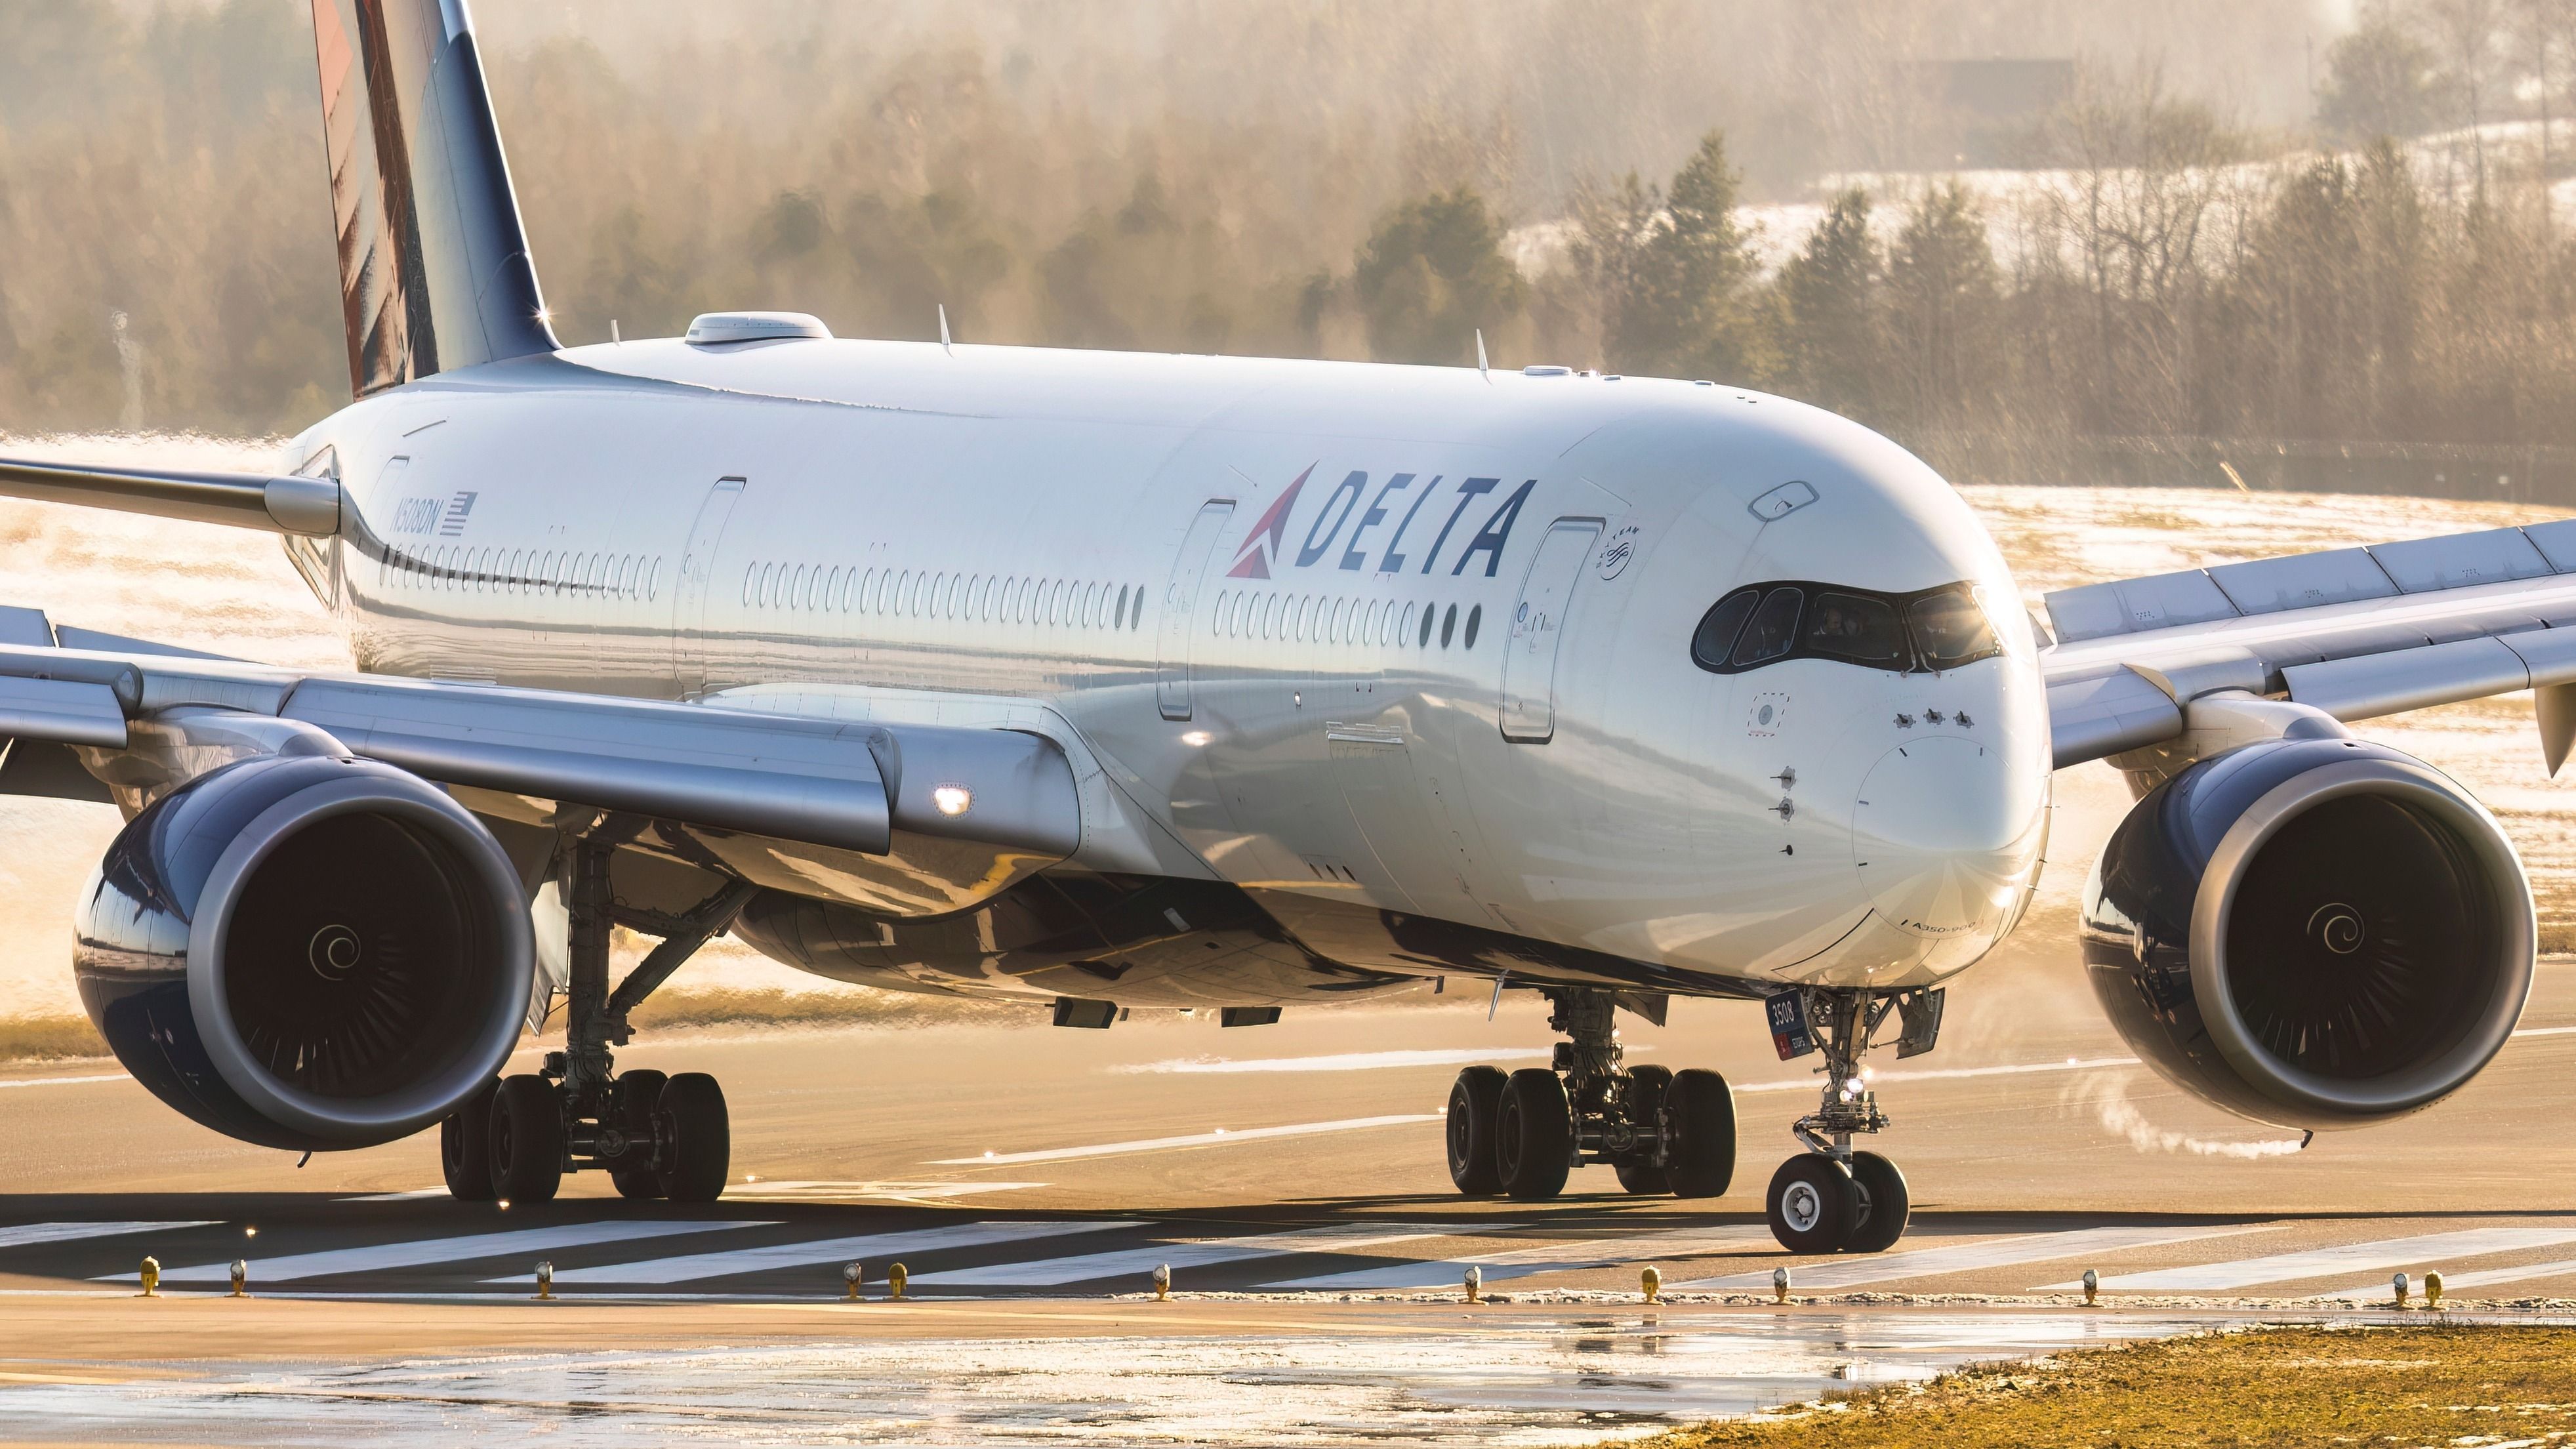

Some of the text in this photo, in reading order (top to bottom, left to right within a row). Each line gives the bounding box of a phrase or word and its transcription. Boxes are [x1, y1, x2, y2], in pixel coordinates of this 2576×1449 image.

[389, 498, 444, 535] N508DN
[1294, 470, 1538, 577] DELTA
[1912, 922, 1976, 933] A350-900
[1772, 1000, 1795, 1026] 3508
